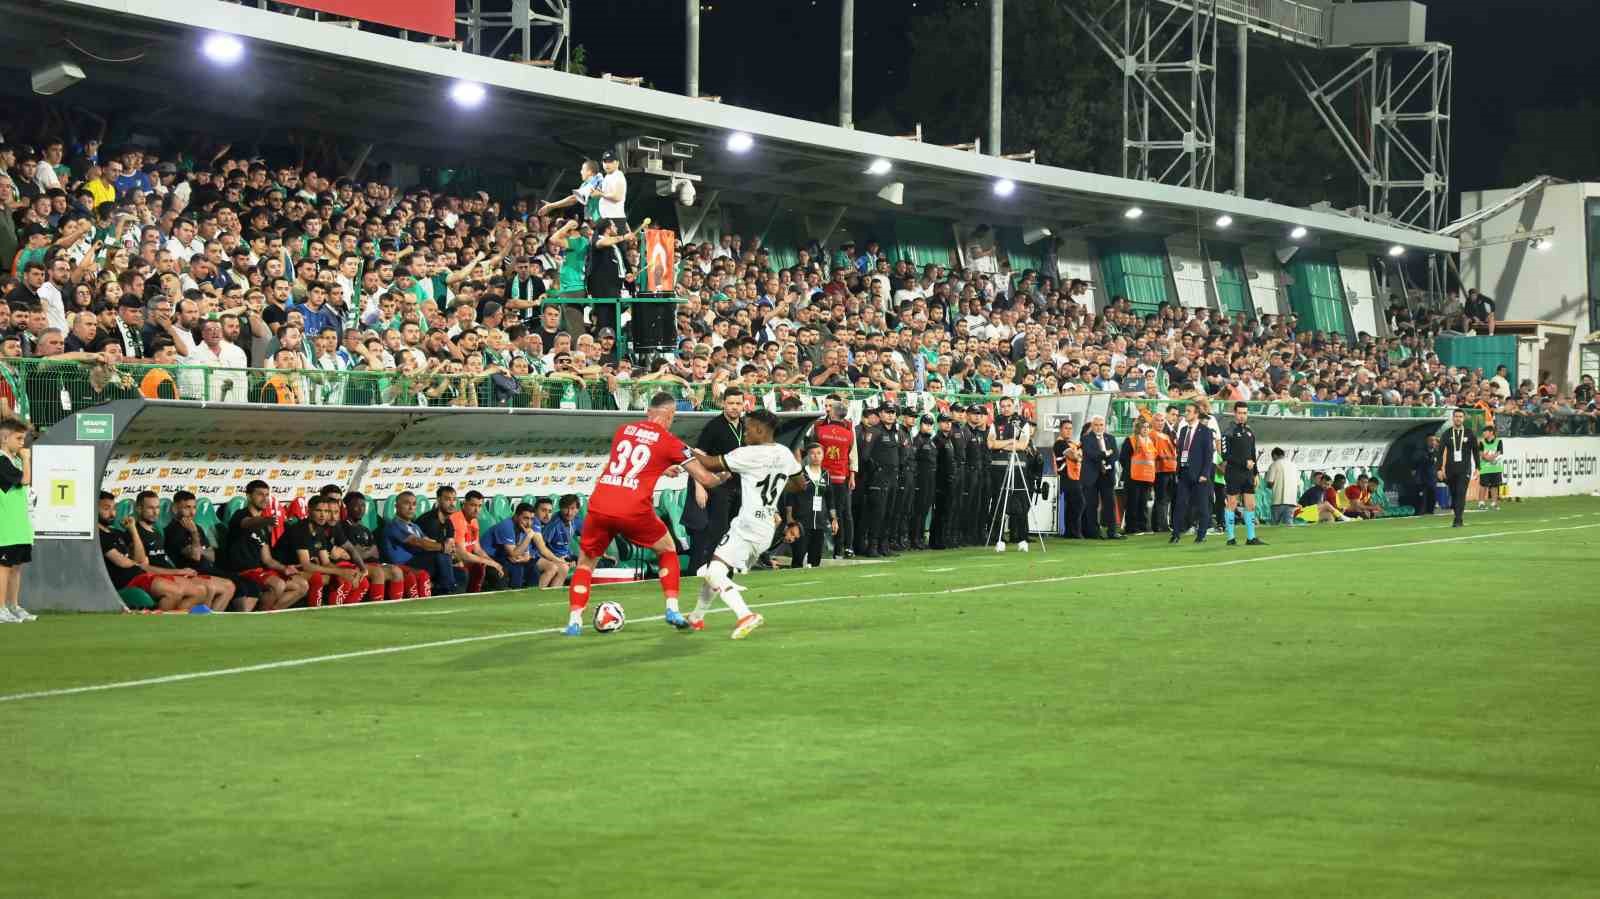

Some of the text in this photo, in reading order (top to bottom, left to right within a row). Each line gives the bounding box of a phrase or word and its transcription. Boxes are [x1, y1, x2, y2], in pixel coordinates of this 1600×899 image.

[609, 440, 652, 481] 39
[131, 467, 156, 476] TALAY
[171, 467, 194, 475] TALAY
[208, 468, 231, 476] TALAY
[245, 468, 266, 476] TALAY
[280, 469, 300, 477] TALAY
[57, 485, 69, 500] T
[122, 485, 148, 493] TALAY
[199, 485, 220, 494] TALAY
[271, 486, 291, 494] TALAY
